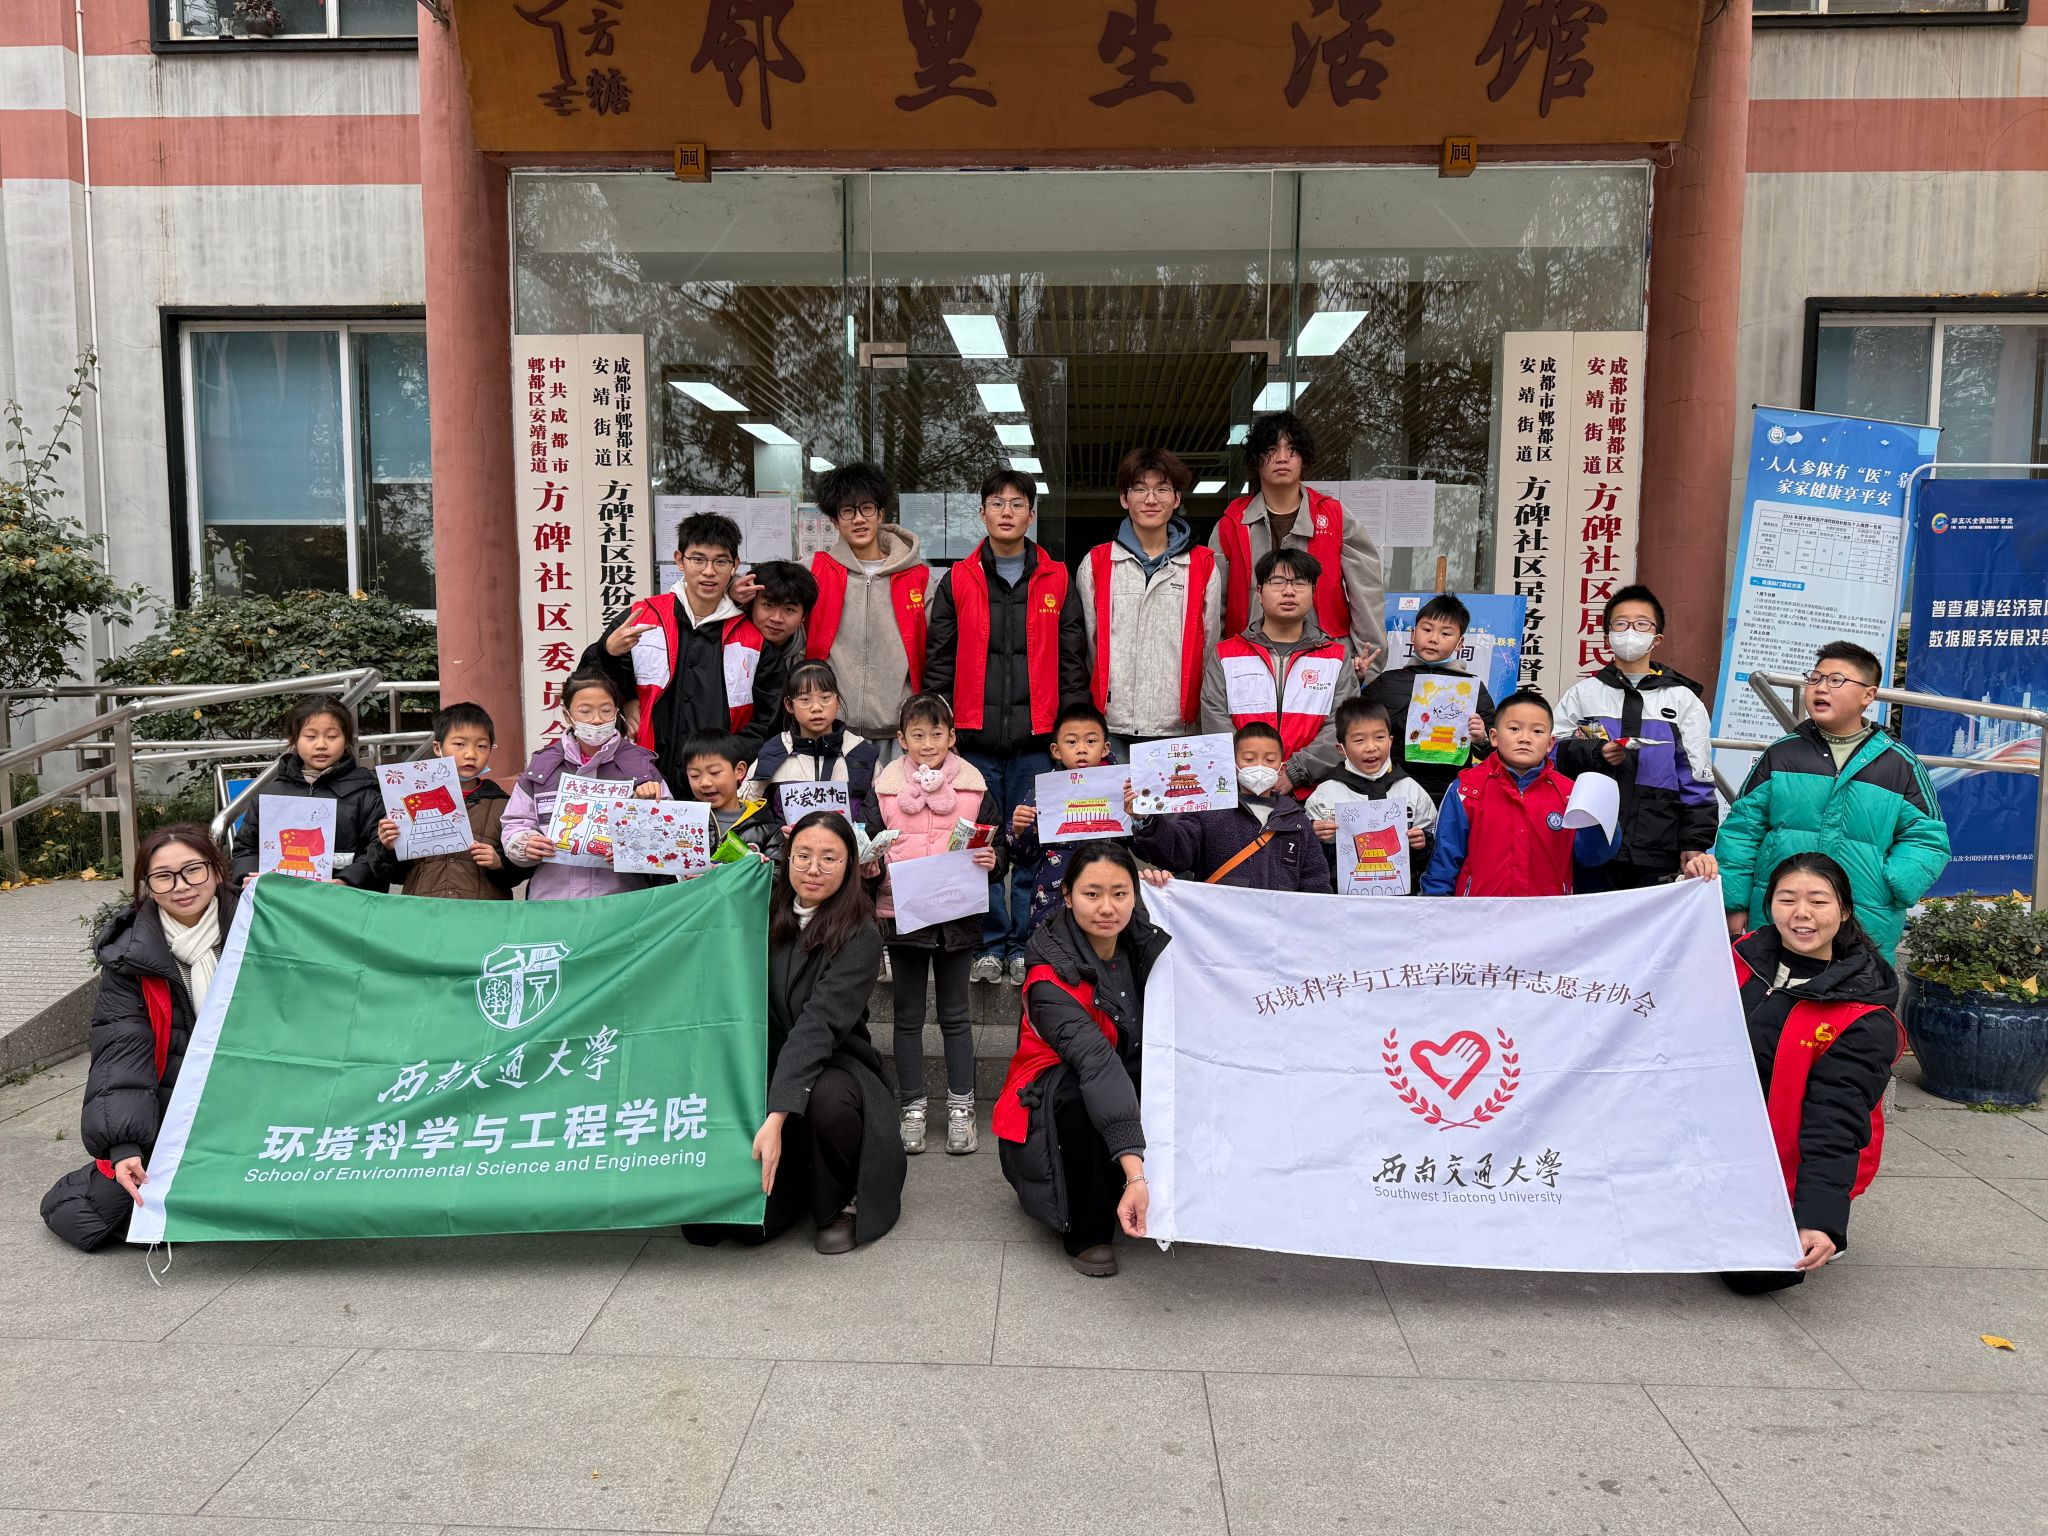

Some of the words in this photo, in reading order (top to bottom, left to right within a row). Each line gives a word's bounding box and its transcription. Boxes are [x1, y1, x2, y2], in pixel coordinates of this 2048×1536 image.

[527, 356, 548, 474] 郫都区安靖街道
[549, 356, 570, 474] 中共成都市
[592, 356, 612, 467] 安靖街道
[613, 356, 634, 467] 成都市郫都区
[1515, 356, 1537, 463] 安靖街道
[1536, 356, 1557, 463] 成都市郫都区
[1582, 356, 1606, 475] 安靖街道
[1606, 356, 1629, 475] 成都市郫都区
[1776, 478, 1893, 507] 家家健康享平安
[1577, 482, 1624, 679] 方碑社区居民
[784, 786, 847, 807] 我爱你中国
[1253, 961, 1658, 1018] 环境科学与工程学院青年志愿者协会
[244, 1168, 311, 1183] School
[313, 1167, 334, 1181] of
[335, 1162, 472, 1181] Environmental
[475, 1160, 550, 1176] Science
[555, 1156, 590, 1172] and
[594, 1149, 706, 1172] Engineering
[258, 1093, 708, 1163] 环境科学与工程学院
[1374, 1186, 1440, 1202] Southwest
[1441, 1191, 1497, 1205] Jiaotong
[1498, 1191, 1563, 1205] University
